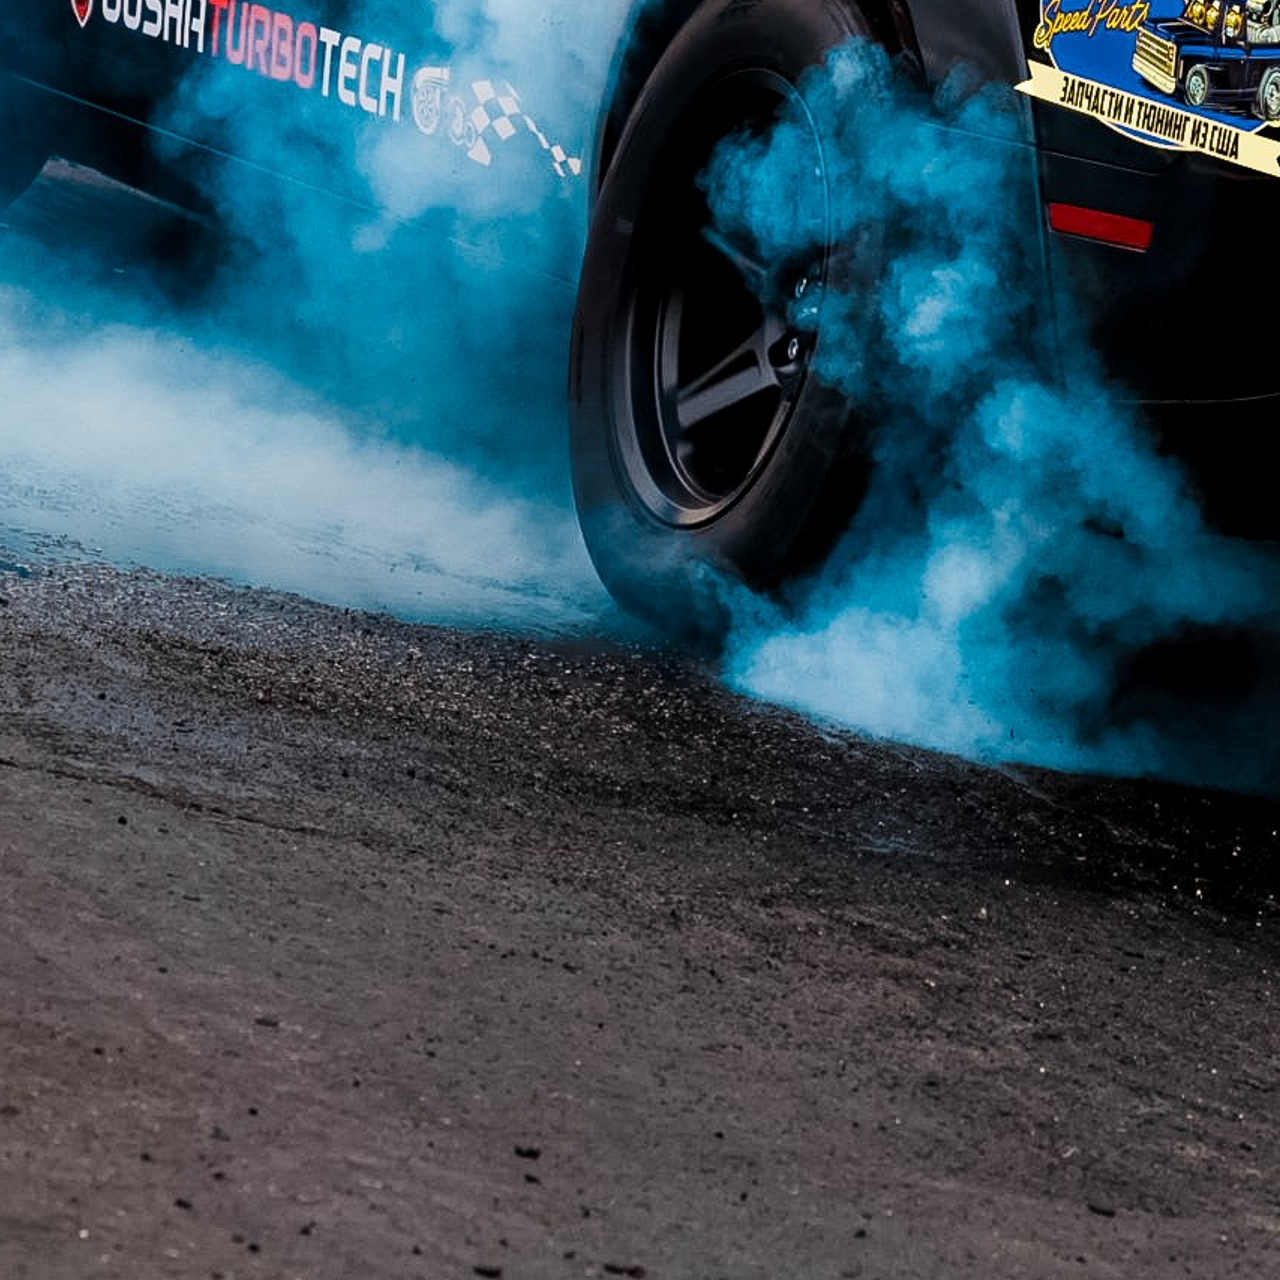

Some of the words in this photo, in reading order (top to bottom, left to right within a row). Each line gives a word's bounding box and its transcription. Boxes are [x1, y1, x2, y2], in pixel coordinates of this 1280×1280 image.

[1059, 75, 1124, 126] ЗАПЧАСТИ
[1124, 98, 1134, 122] И
[1135, 100, 1191, 142] ТЮНИНГ
[1190, 120, 1208, 150] ИЗ
[1208, 128, 1241, 161] США
